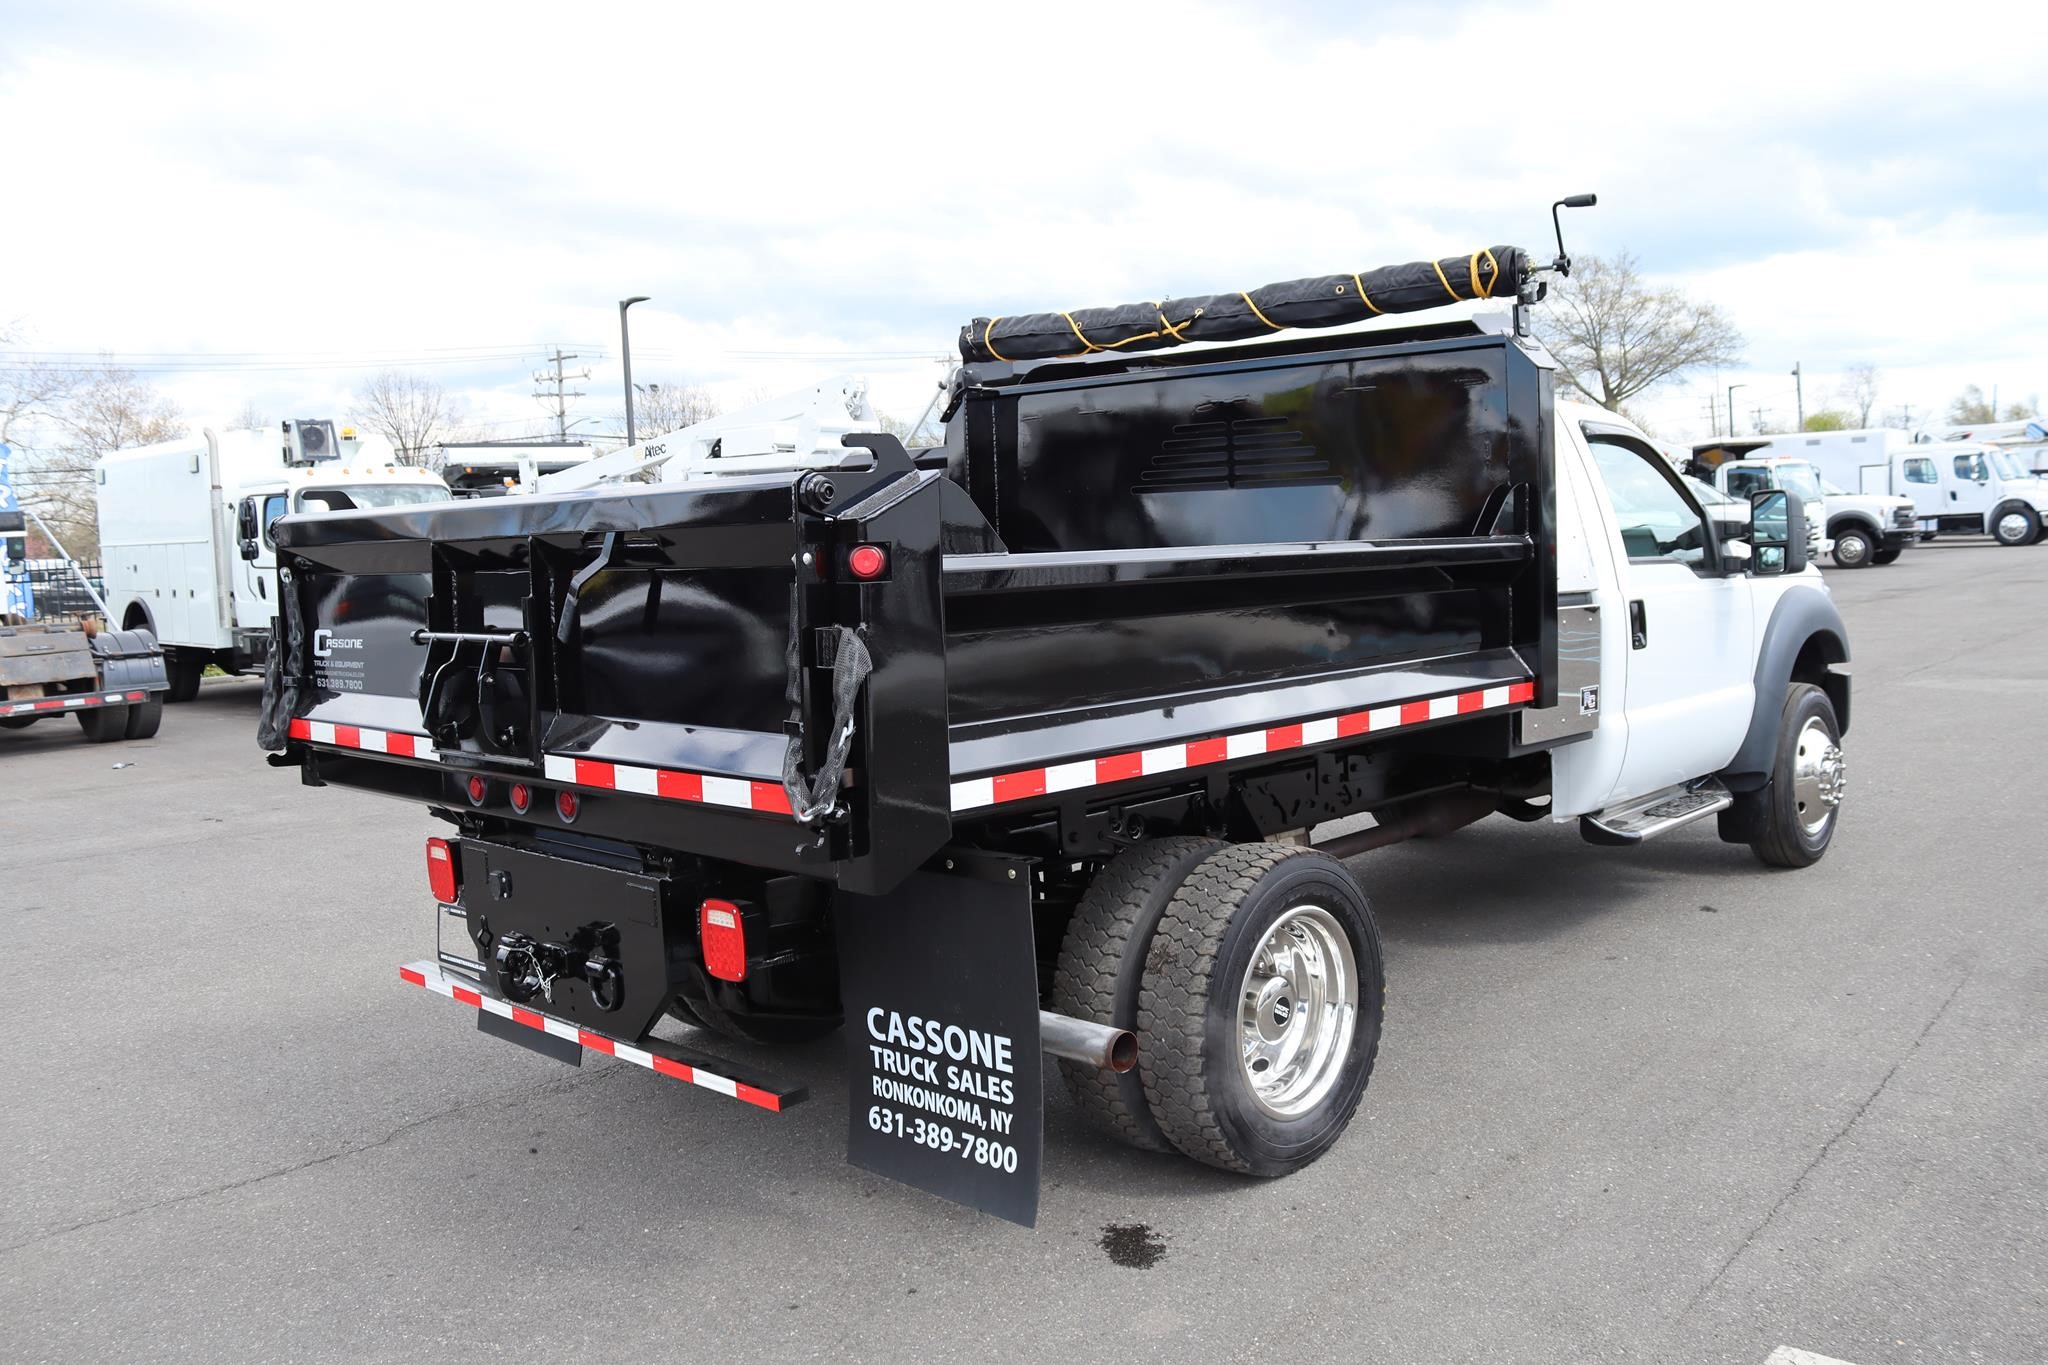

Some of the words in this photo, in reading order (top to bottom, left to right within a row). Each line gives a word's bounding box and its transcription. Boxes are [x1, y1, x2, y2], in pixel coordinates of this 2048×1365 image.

[645, 443, 667, 460] Altec
[313, 660, 330, 668] TRUCK
[335, 660, 364, 669] EQUIPMENT
[316, 678, 363, 690] 631.389.7800
[866, 1006, 1014, 1074] CASSONE
[869, 1044, 939, 1085] TRUCK
[946, 1066, 1014, 1105] SALES
[872, 1075, 987, 1131] RONKONKOMA,
[990, 1108, 1013, 1135] NY
[868, 1105, 1018, 1173] 631-389-7800
